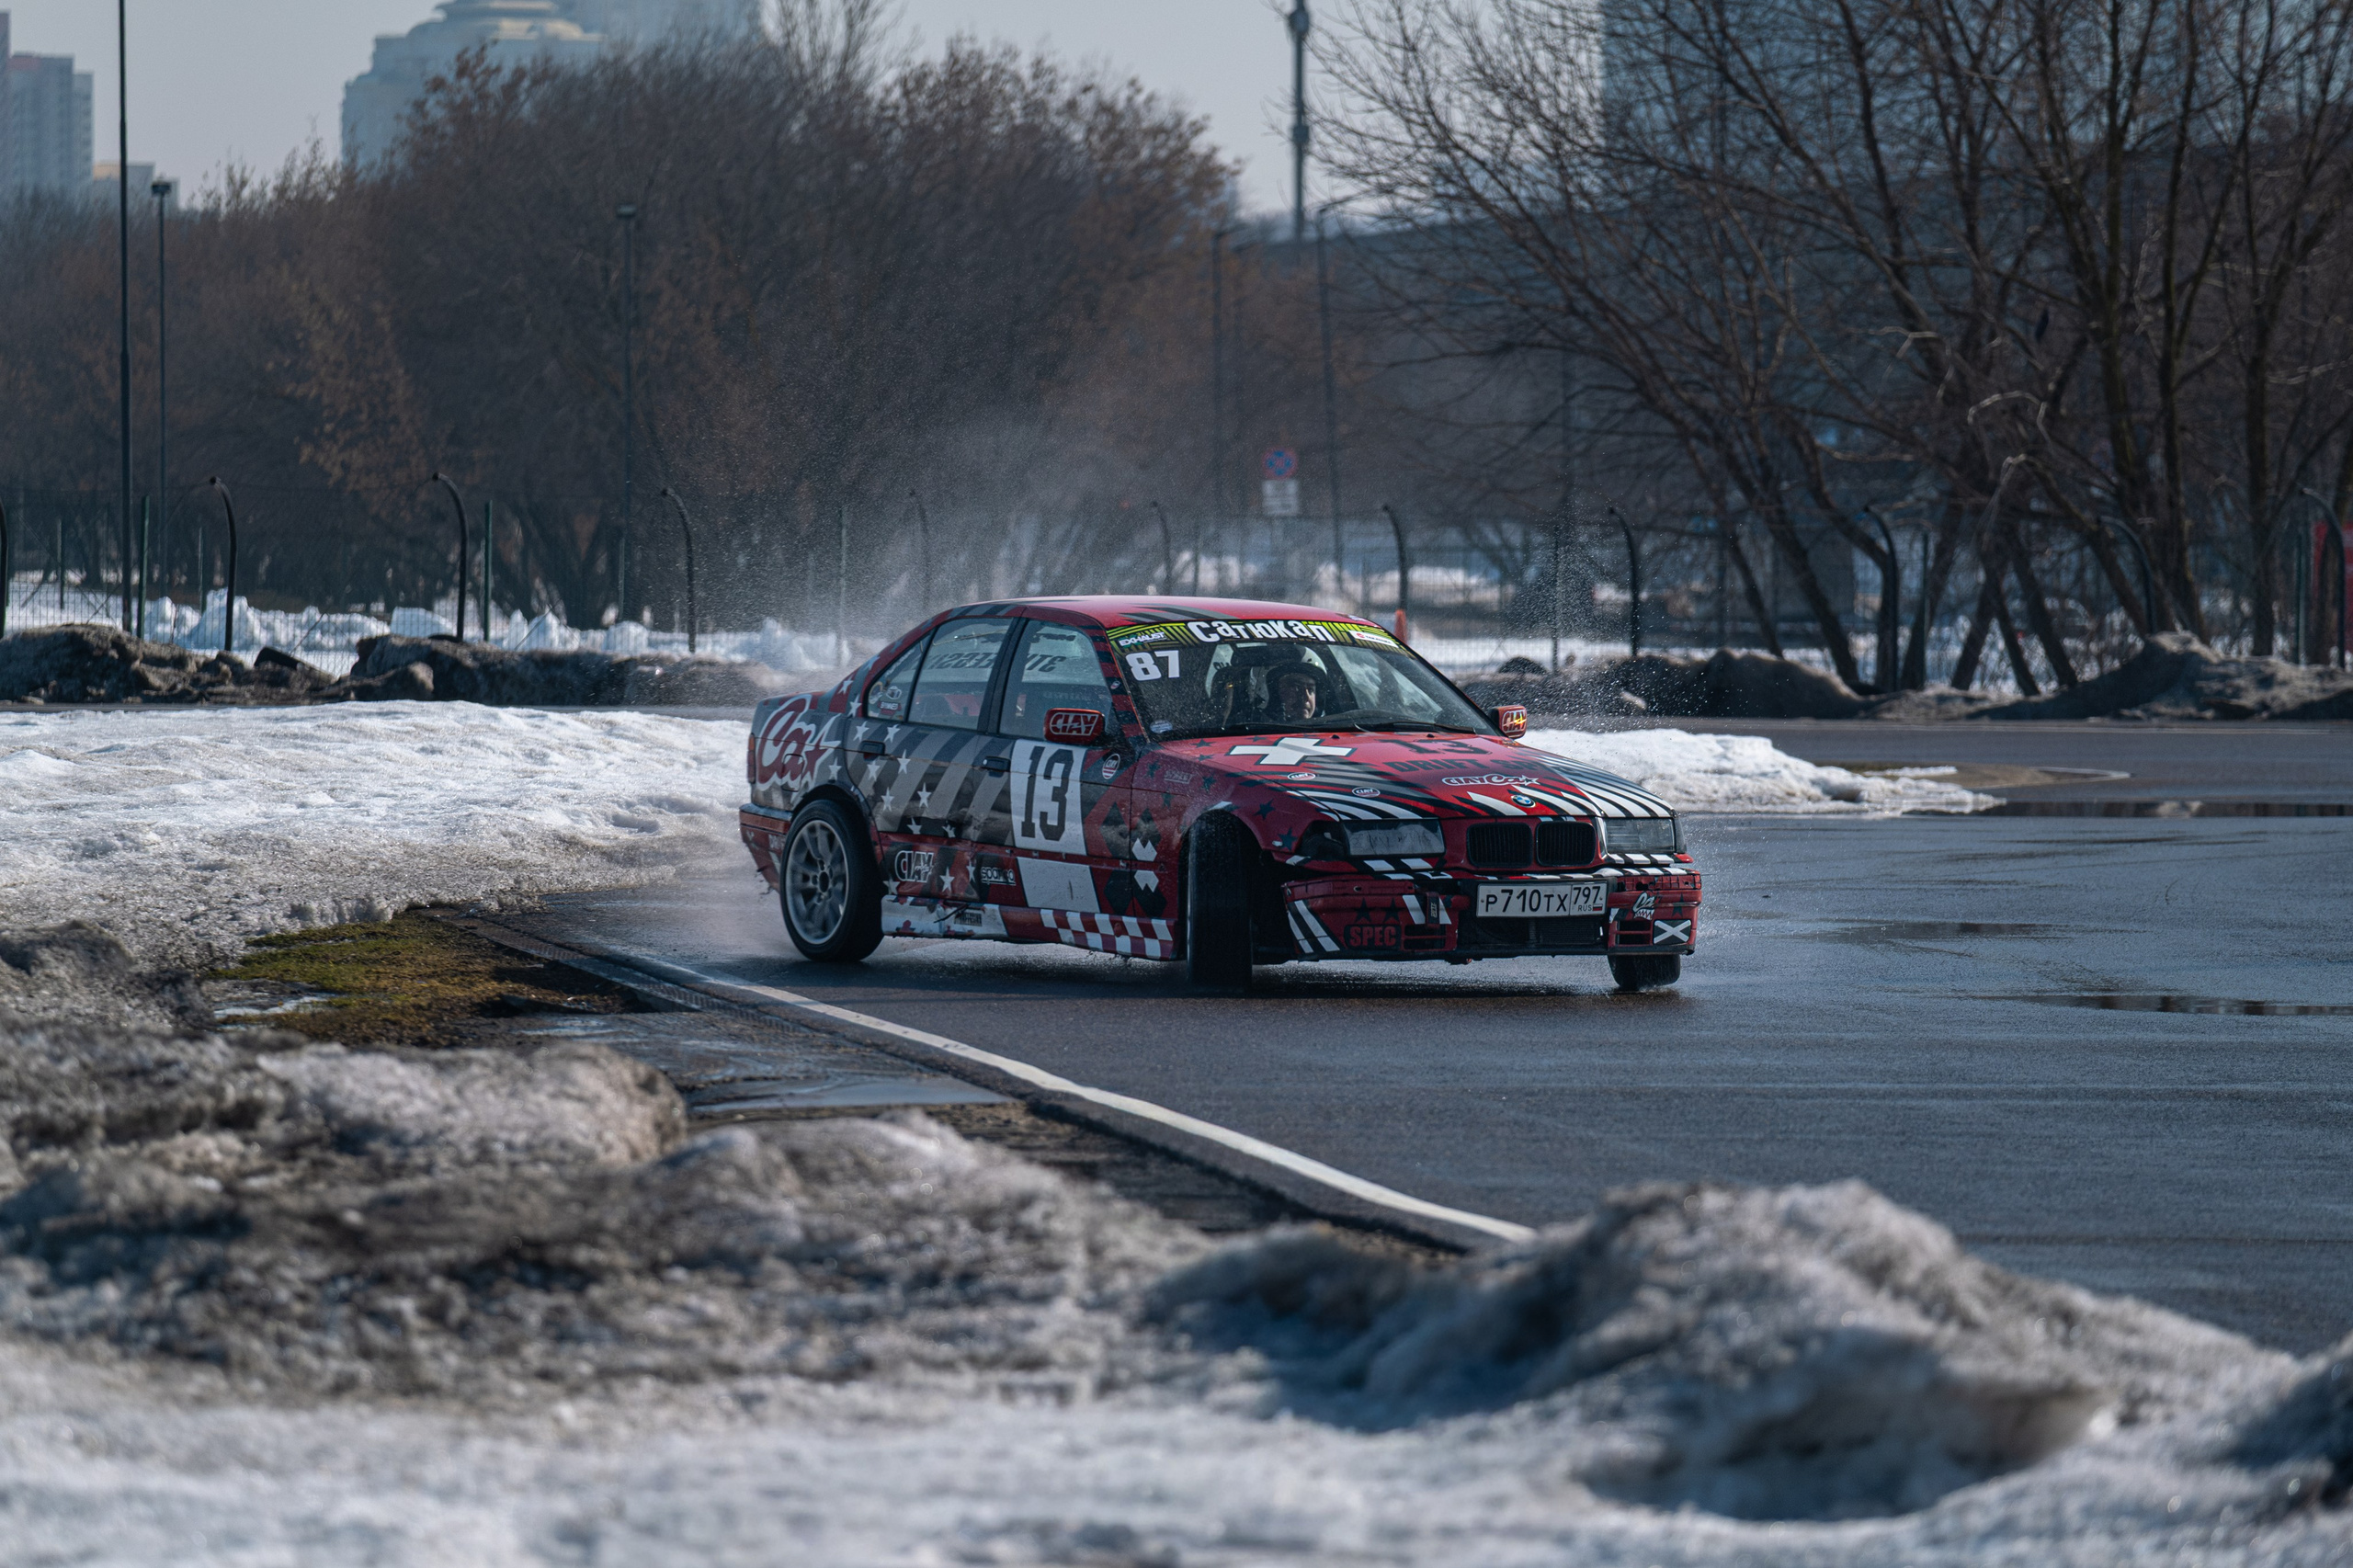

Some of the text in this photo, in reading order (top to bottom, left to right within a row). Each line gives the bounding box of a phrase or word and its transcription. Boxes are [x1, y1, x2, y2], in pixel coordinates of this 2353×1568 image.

[1120, 631, 1165, 646] EXHAUST
[1126, 650, 1180, 681] 87
[1375, 739, 1493, 755] 13
[1381, 758, 1486, 773] DRIFT
[1020, 745, 1069, 841] 13
[1574, 886, 1602, 905] 797
[1577, 904, 1592, 913] RUS
[1349, 926, 1397, 948] SPEC
